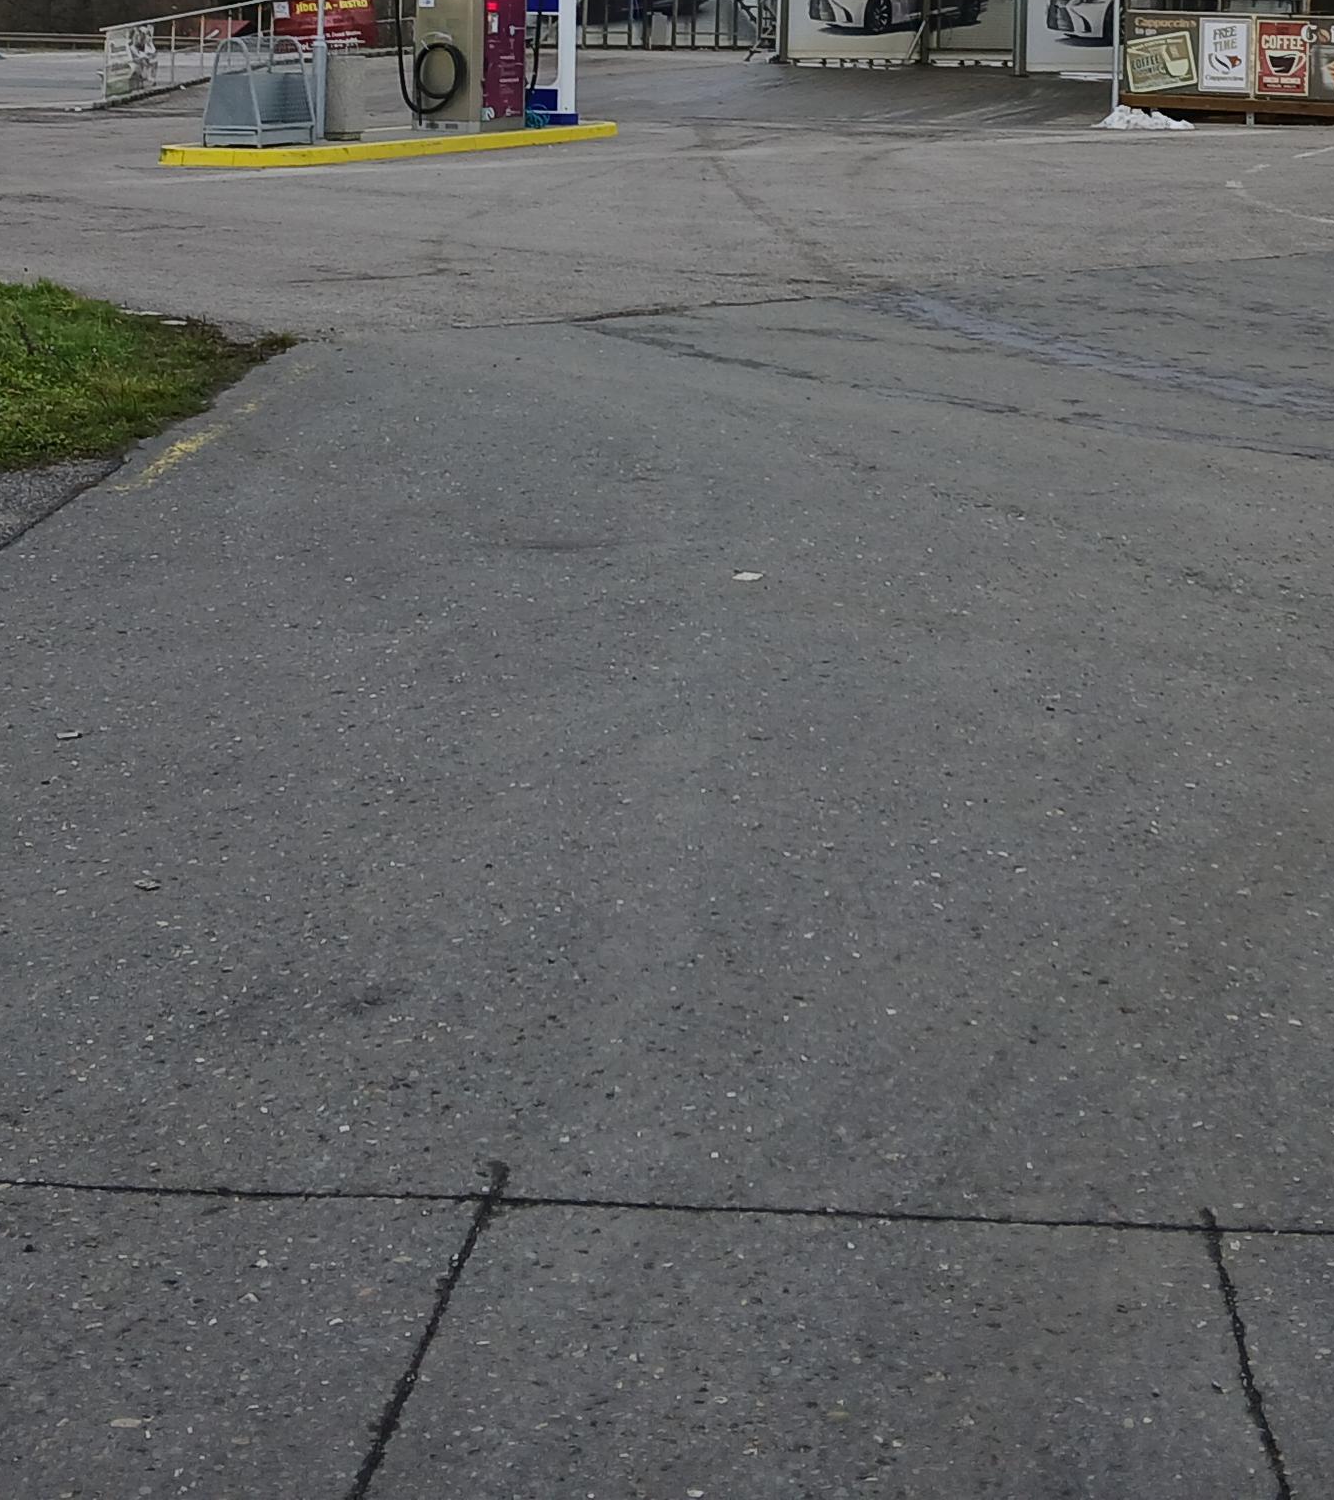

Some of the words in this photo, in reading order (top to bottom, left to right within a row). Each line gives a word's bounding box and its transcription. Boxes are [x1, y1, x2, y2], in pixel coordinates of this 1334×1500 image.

[296, 3, 332, 15] JÍDELA
[1213, 26, 1237, 40] FREE
[1213, 41, 1237, 52] TIME
[1261, 35, 1305, 50] COFFEE
